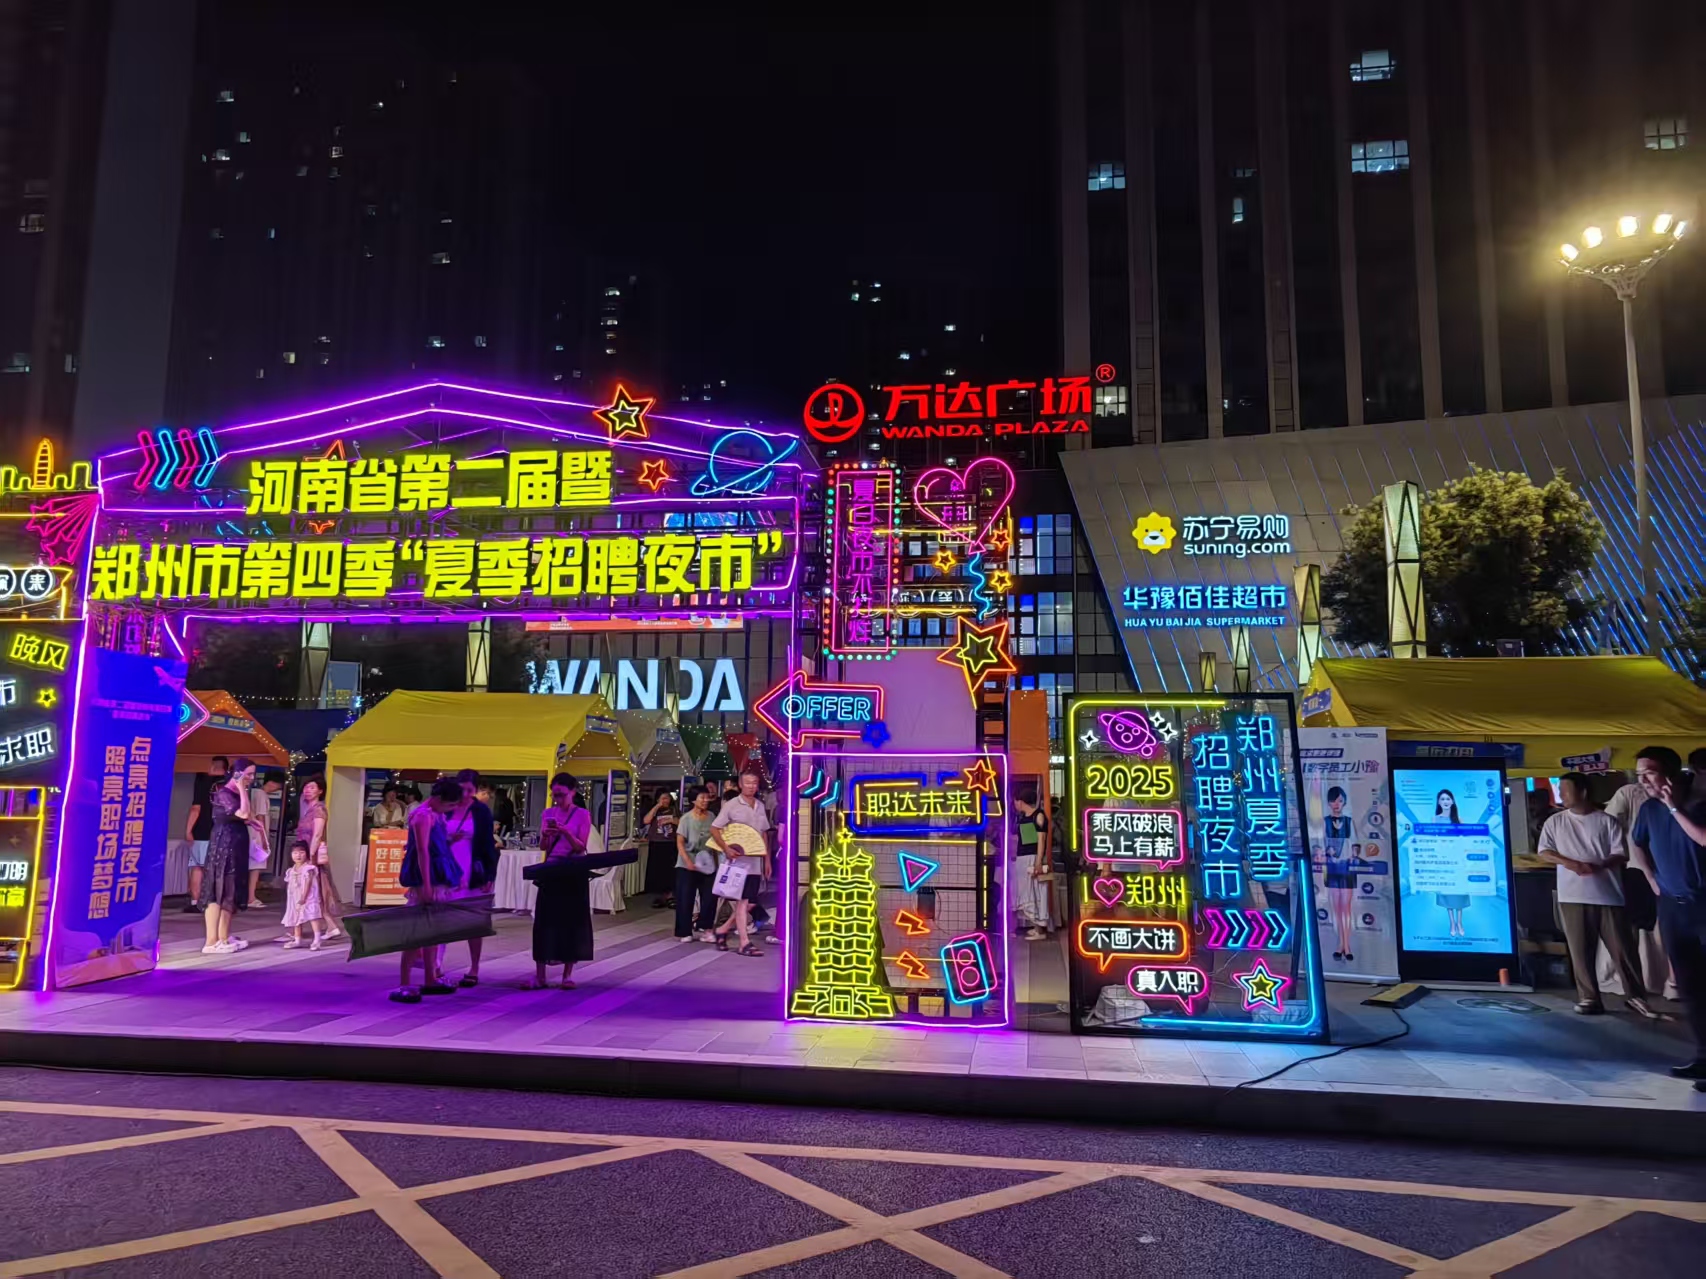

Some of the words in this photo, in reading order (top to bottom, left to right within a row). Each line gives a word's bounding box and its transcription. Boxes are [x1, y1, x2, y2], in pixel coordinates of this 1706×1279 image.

[882, 376, 1091, 421] 万达广场
[881, 424, 984, 439] WANDA
[994, 419, 1090, 435] PLAZA
[249, 450, 612, 514] 河南省第二届暨
[1182, 513, 1290, 541] 苏宁易购
[1183, 541, 1291, 559] suning.com
[1123, 584, 1287, 611] 华豫佰佳超市
[1125, 618, 1147, 628] HUA
[1206, 616, 1286, 627] SUPERMARKET
[9, 632, 70, 670] 晚风
[782, 694, 871, 721] OFFER
[1086, 764, 1174, 798] 2025
[865, 789, 973, 818] 职达未来
[1236, 715, 1289, 880] 郑州夏季
[115, 736, 152, 903] 点亮招聘夜市
[1092, 812, 1174, 833] 乘风破浪
[1193, 734, 1242, 899] 招聘夜市
[88, 745, 126, 919] 照亮职场梦想
[1093, 836, 1175, 858] 马上有薪
[1126, 875, 1186, 906] 郑州
[1088, 927, 1177, 952] 不画大饼
[1136, 969, 1200, 994] 真入职
